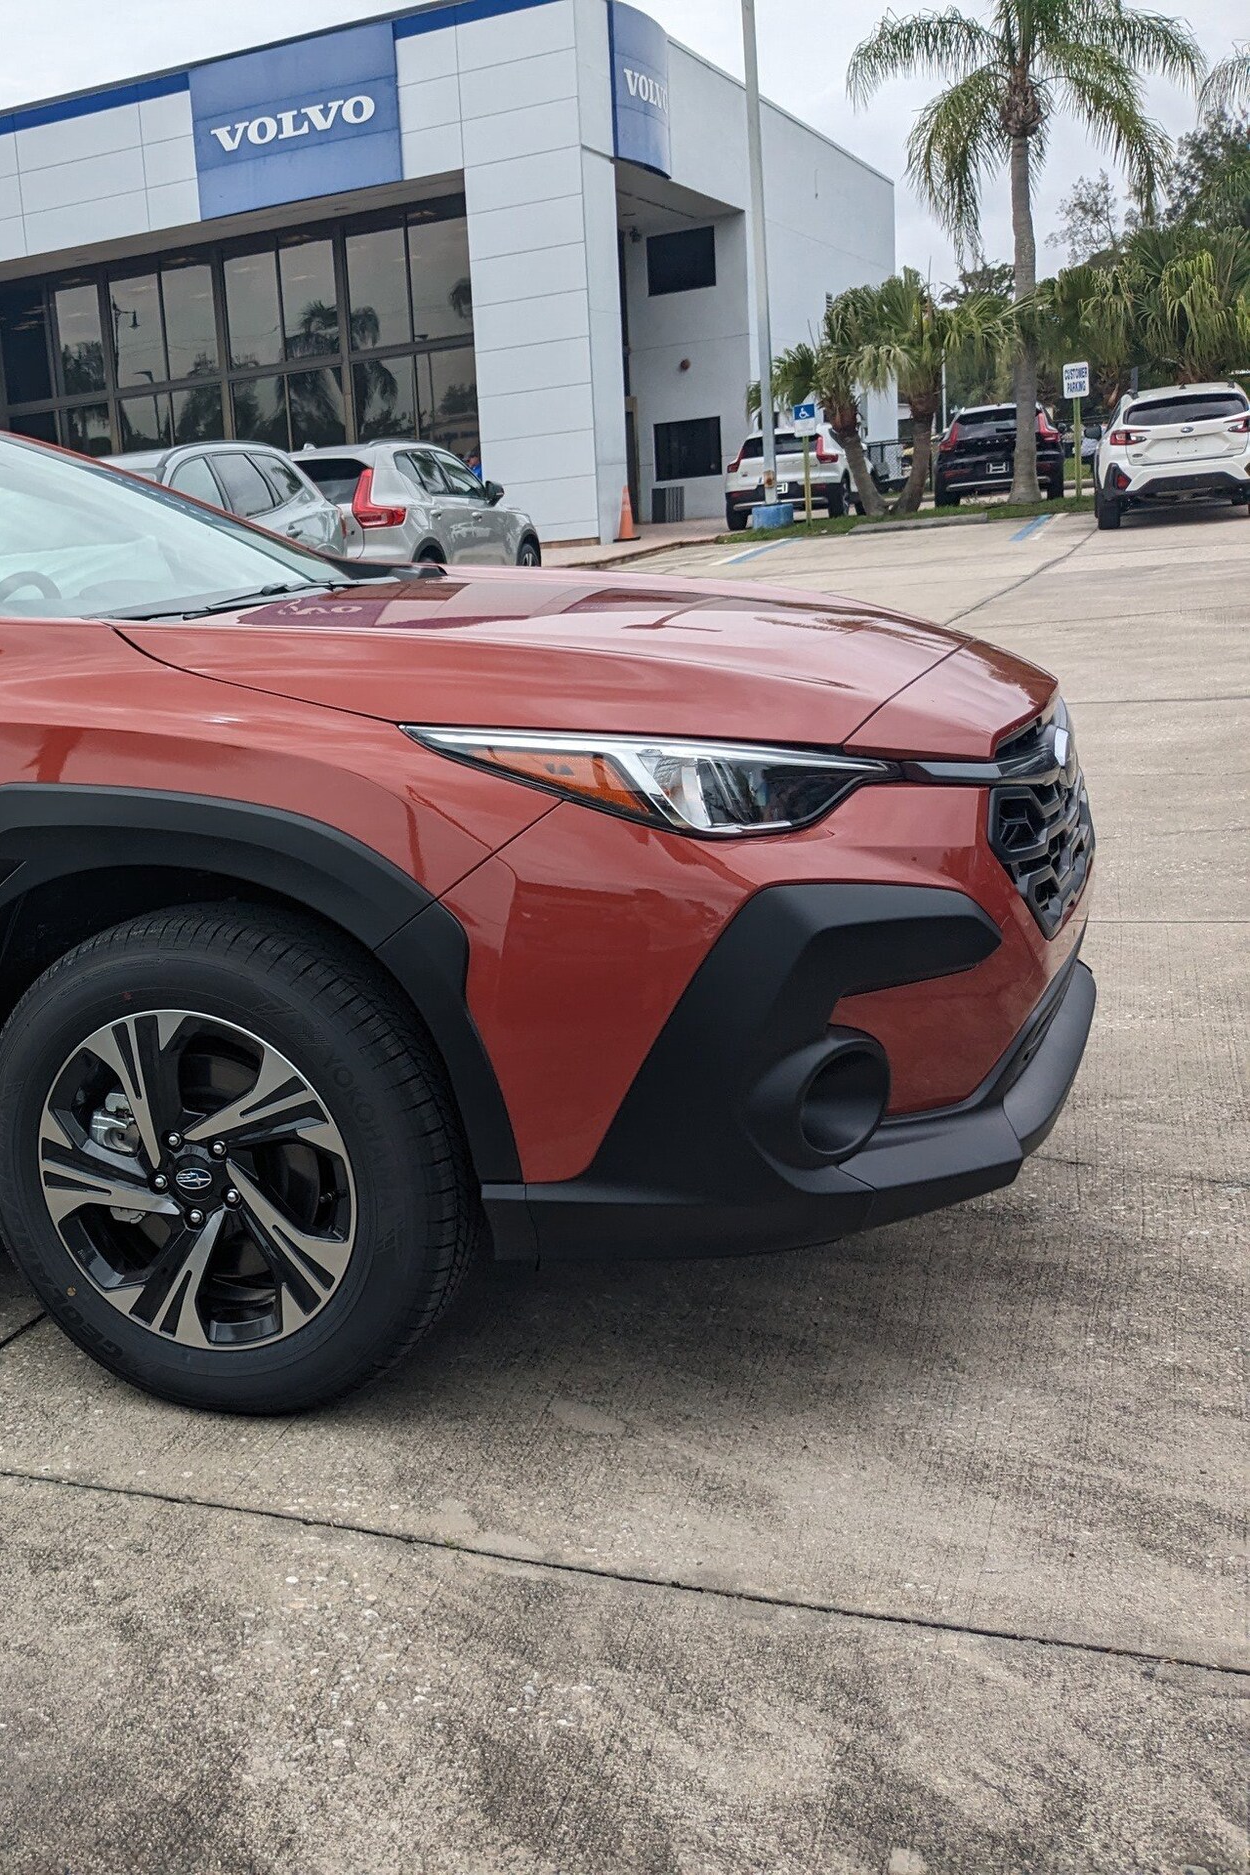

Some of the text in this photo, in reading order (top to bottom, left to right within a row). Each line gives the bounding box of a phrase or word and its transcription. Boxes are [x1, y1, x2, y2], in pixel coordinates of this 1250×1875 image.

[210, 95, 375, 152] VOLVO
[1064, 367, 1088, 380] CUSTOMER
[1067, 380, 1086, 392] PARKING
